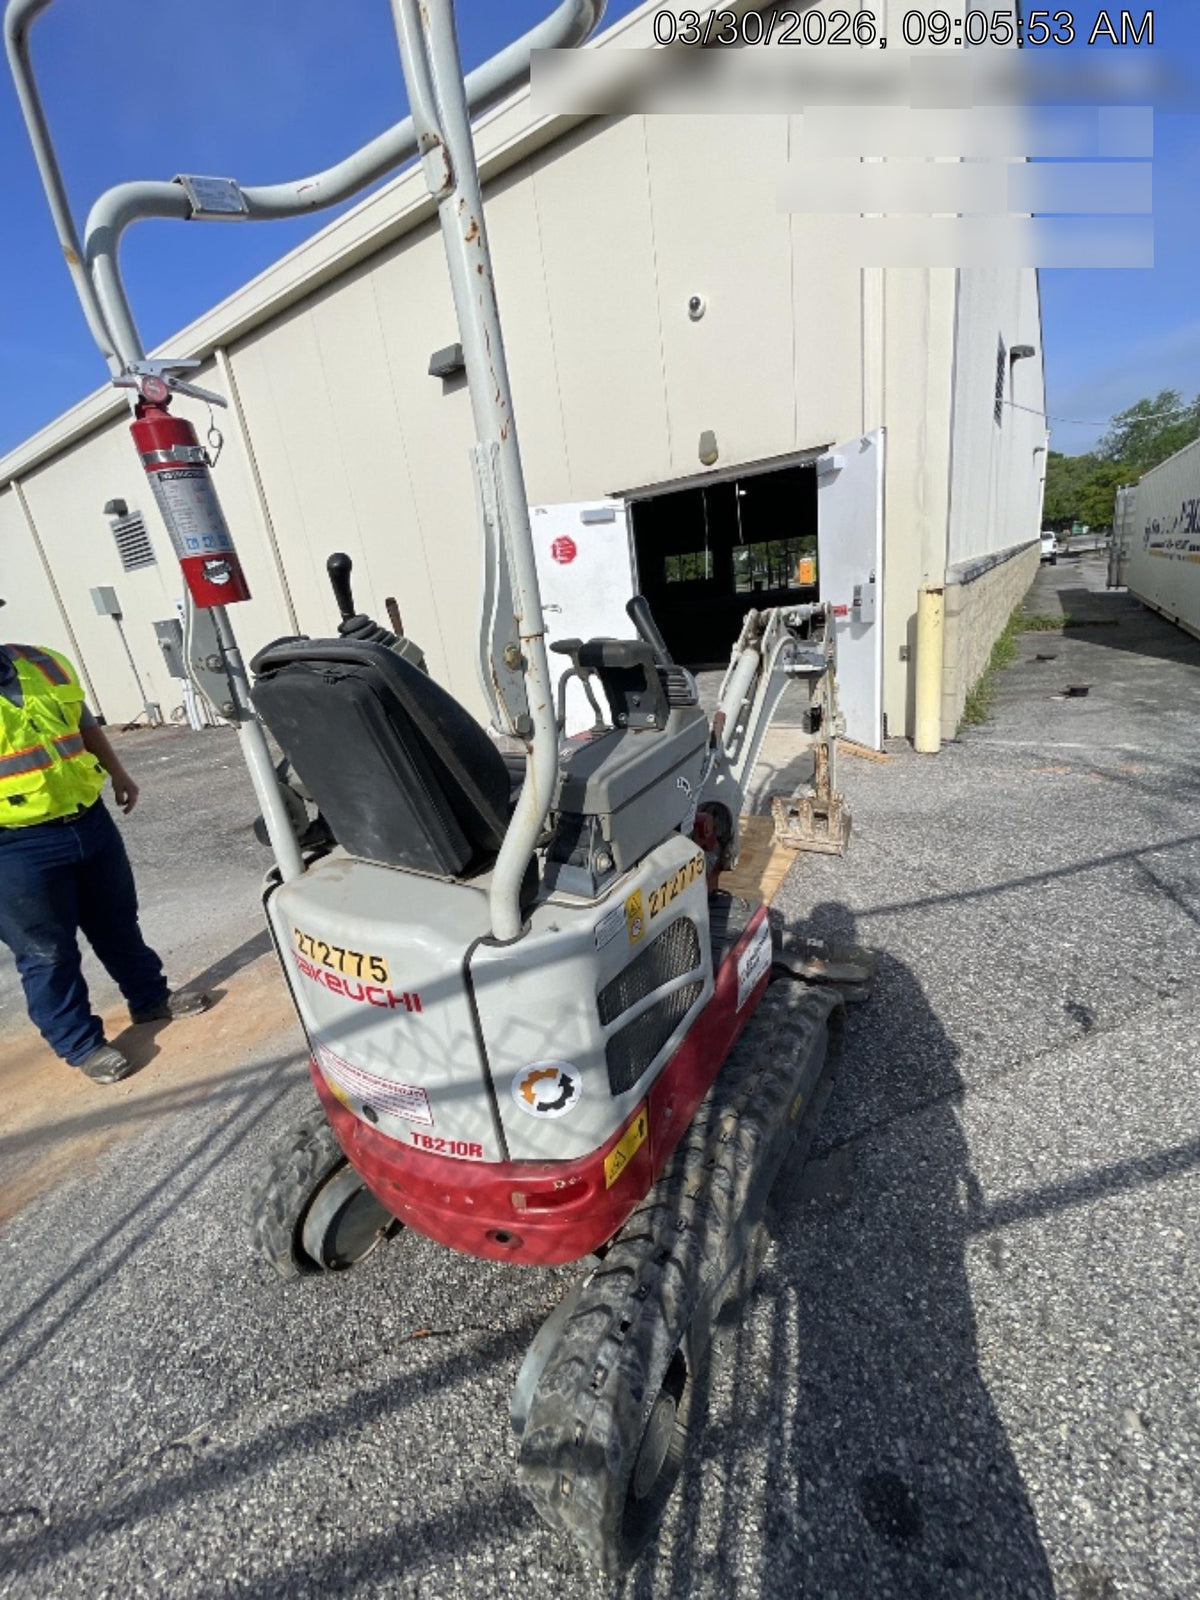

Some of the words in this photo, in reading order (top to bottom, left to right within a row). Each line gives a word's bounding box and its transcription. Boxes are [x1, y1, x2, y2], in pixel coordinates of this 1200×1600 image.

[648, 851, 705, 918] 272775
[294, 927, 388, 984] 272775
[410, 1131, 483, 1158] TB210R
